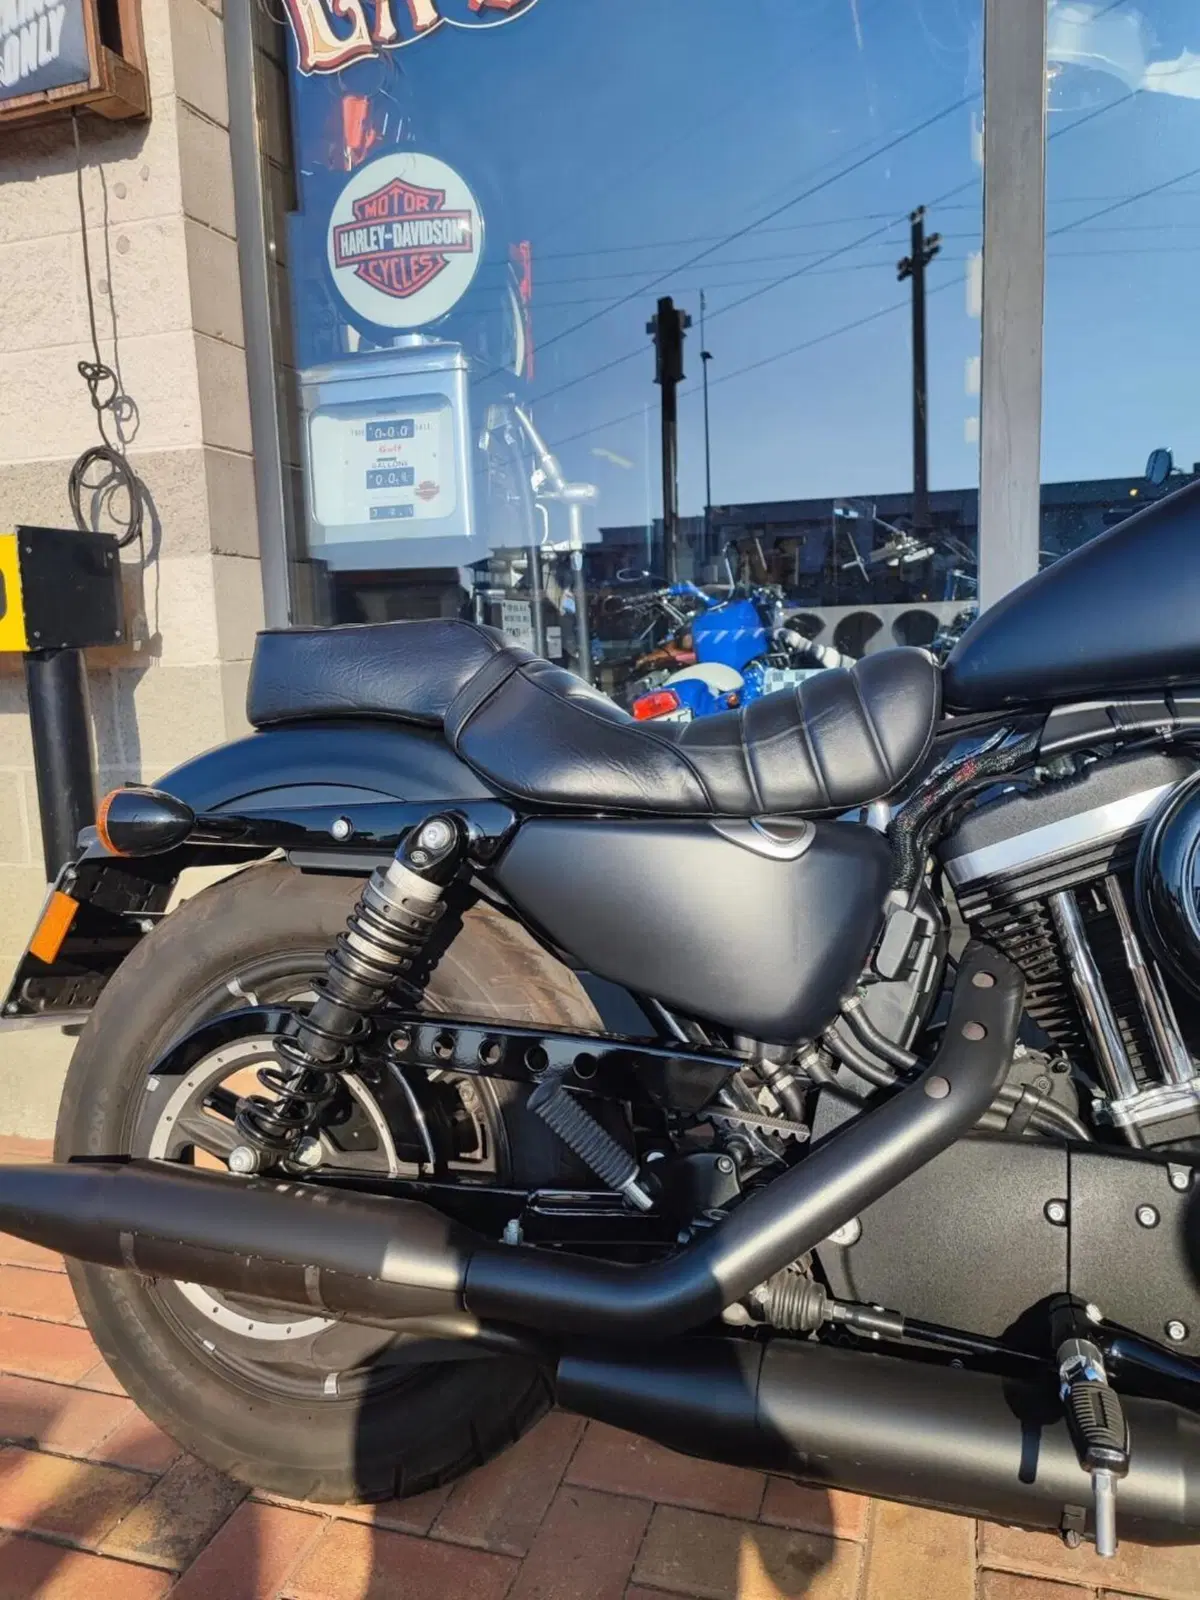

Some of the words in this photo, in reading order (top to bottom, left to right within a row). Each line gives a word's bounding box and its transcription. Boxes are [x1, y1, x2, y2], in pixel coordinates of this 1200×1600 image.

[4, 4, 65, 87] ONLY
[364, 188, 429, 217] MOTOR
[340, 218, 463, 257] HARLEY-DAVIDSON
[368, 254, 432, 289] CYCLES
